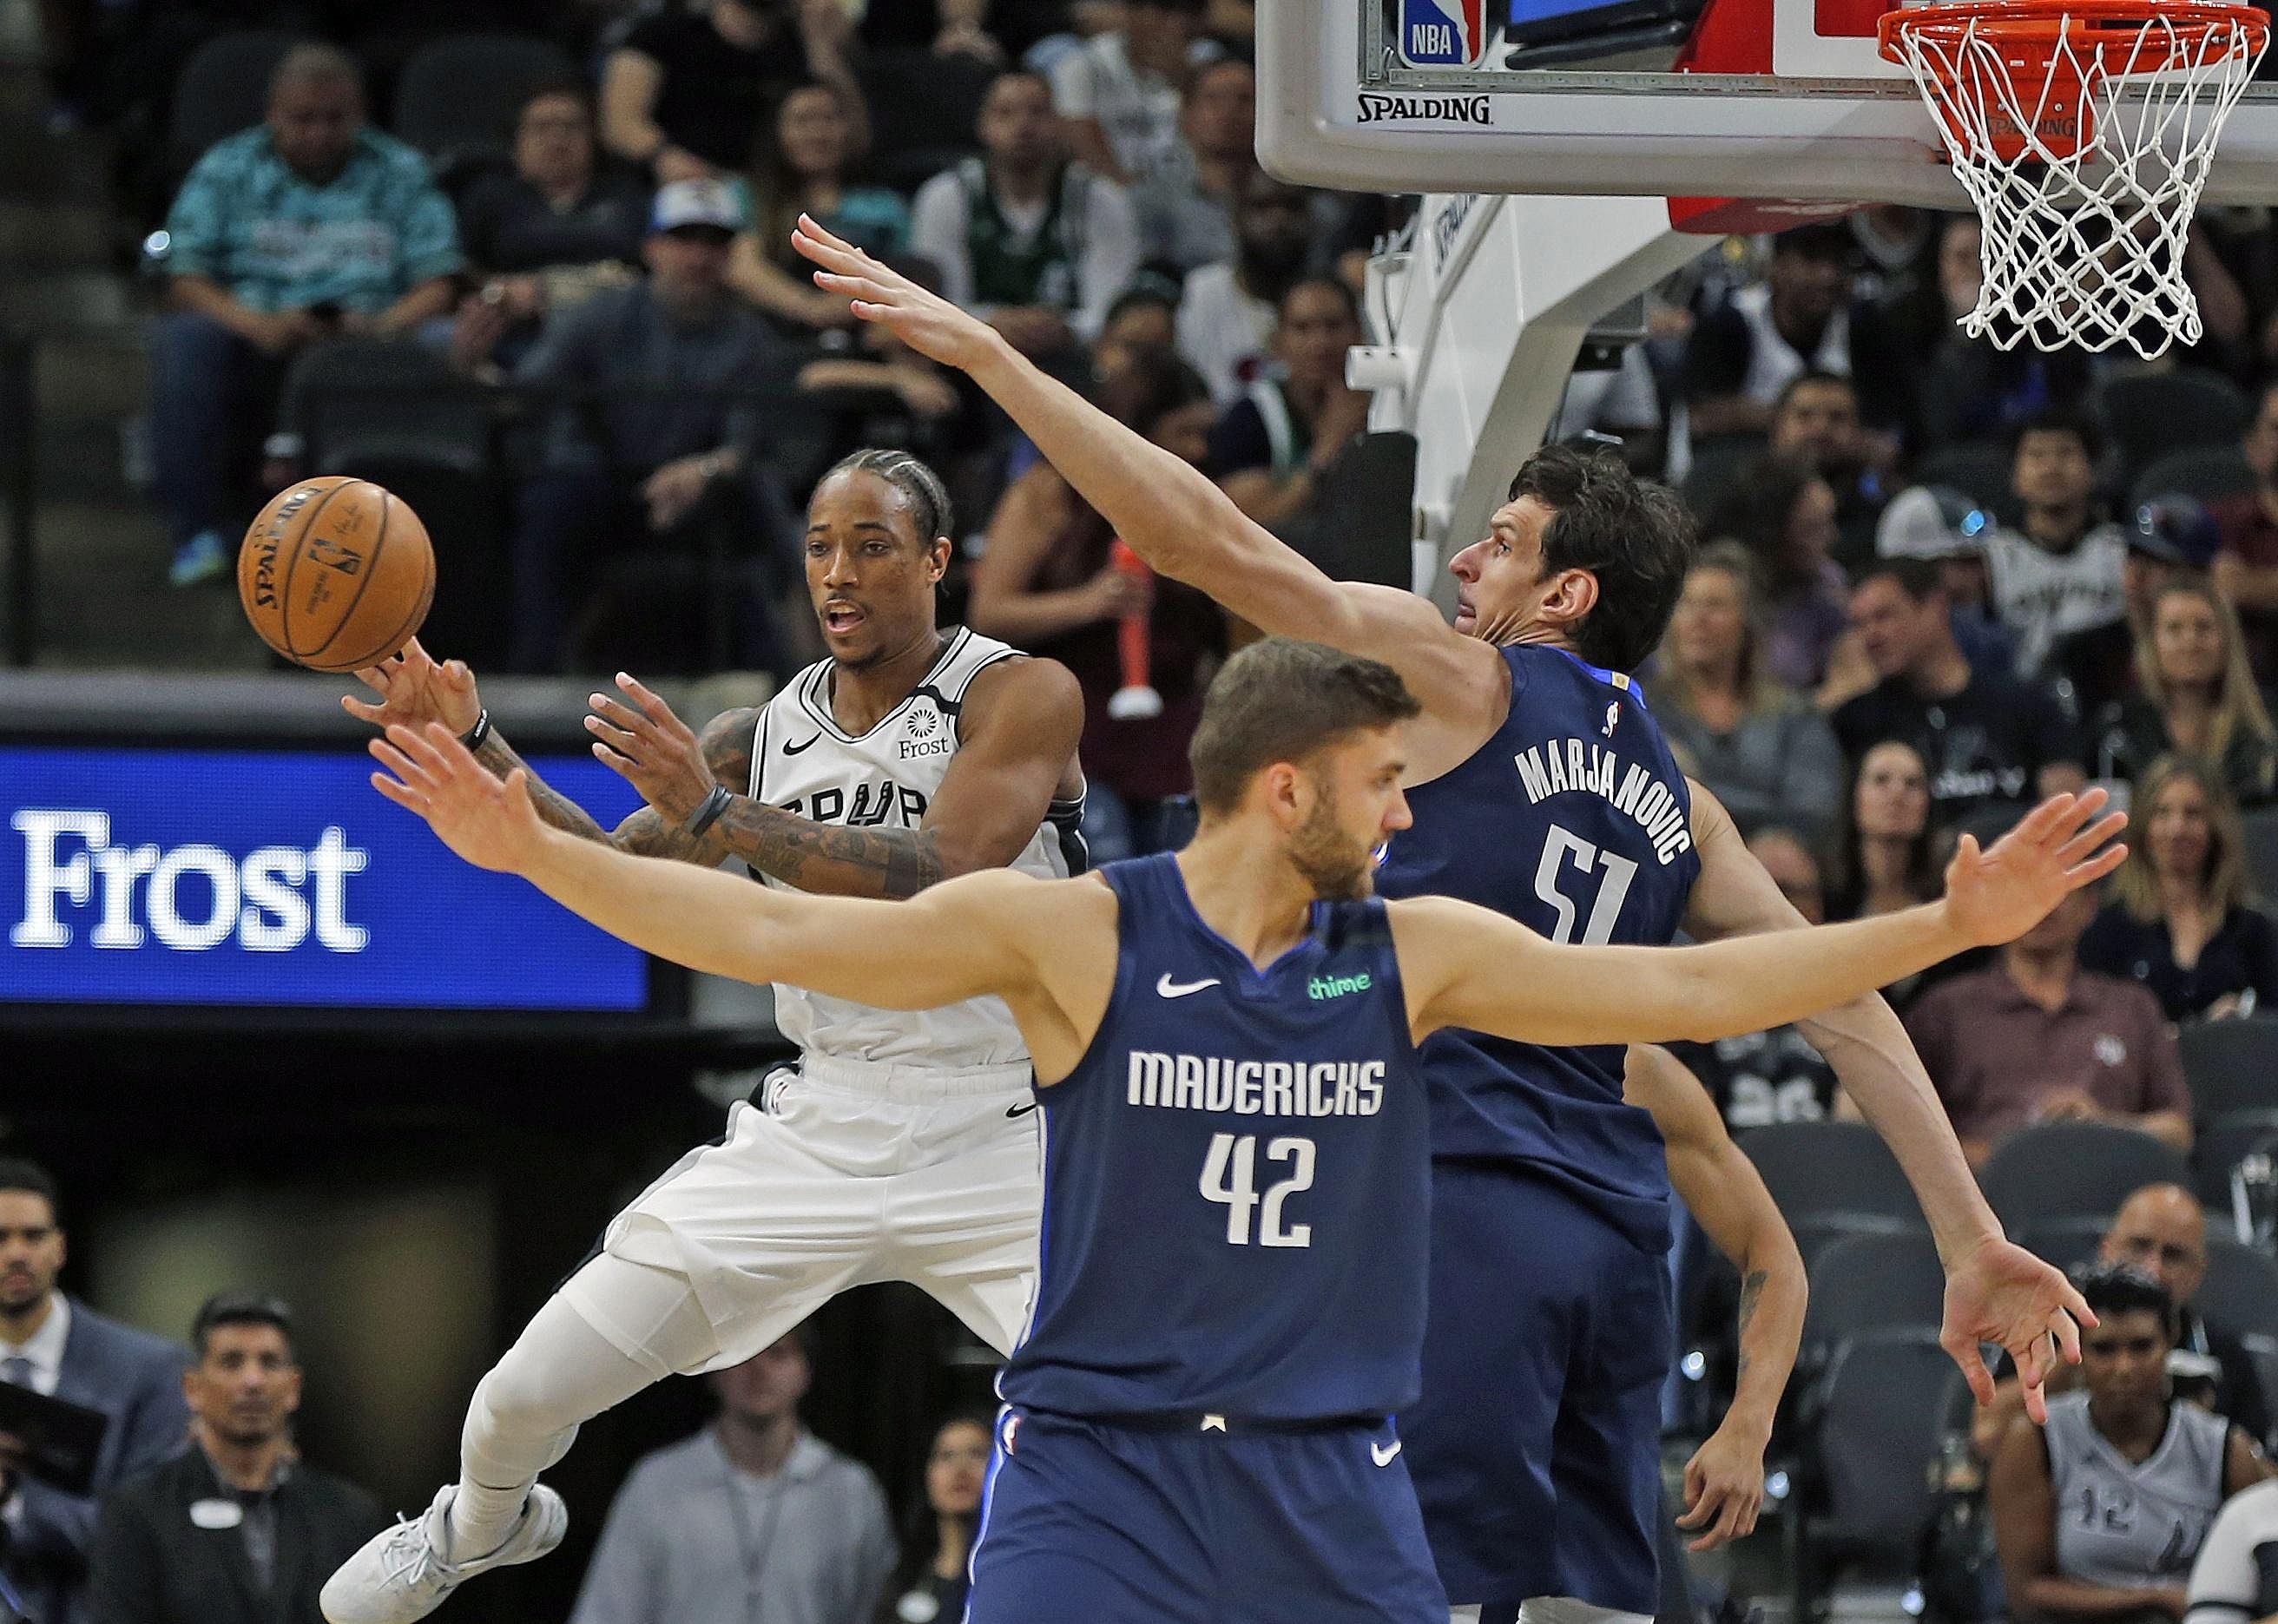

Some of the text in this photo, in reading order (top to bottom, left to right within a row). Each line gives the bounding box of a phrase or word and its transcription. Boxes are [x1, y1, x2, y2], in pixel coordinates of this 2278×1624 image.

[1412, 23, 1452, 55] NBA
[1357, 94, 1491, 125] SPALDING
[898, 737, 950, 759] Frost
[1514, 738, 1691, 866] MARJANOVIC
[10, 807, 372, 953] Frost
[1534, 823, 1639, 944] 51
[1307, 972, 1372, 1001] chime
[1127, 1050, 1386, 1117] MAVERICKS
[1199, 1132, 1318, 1248] 42
